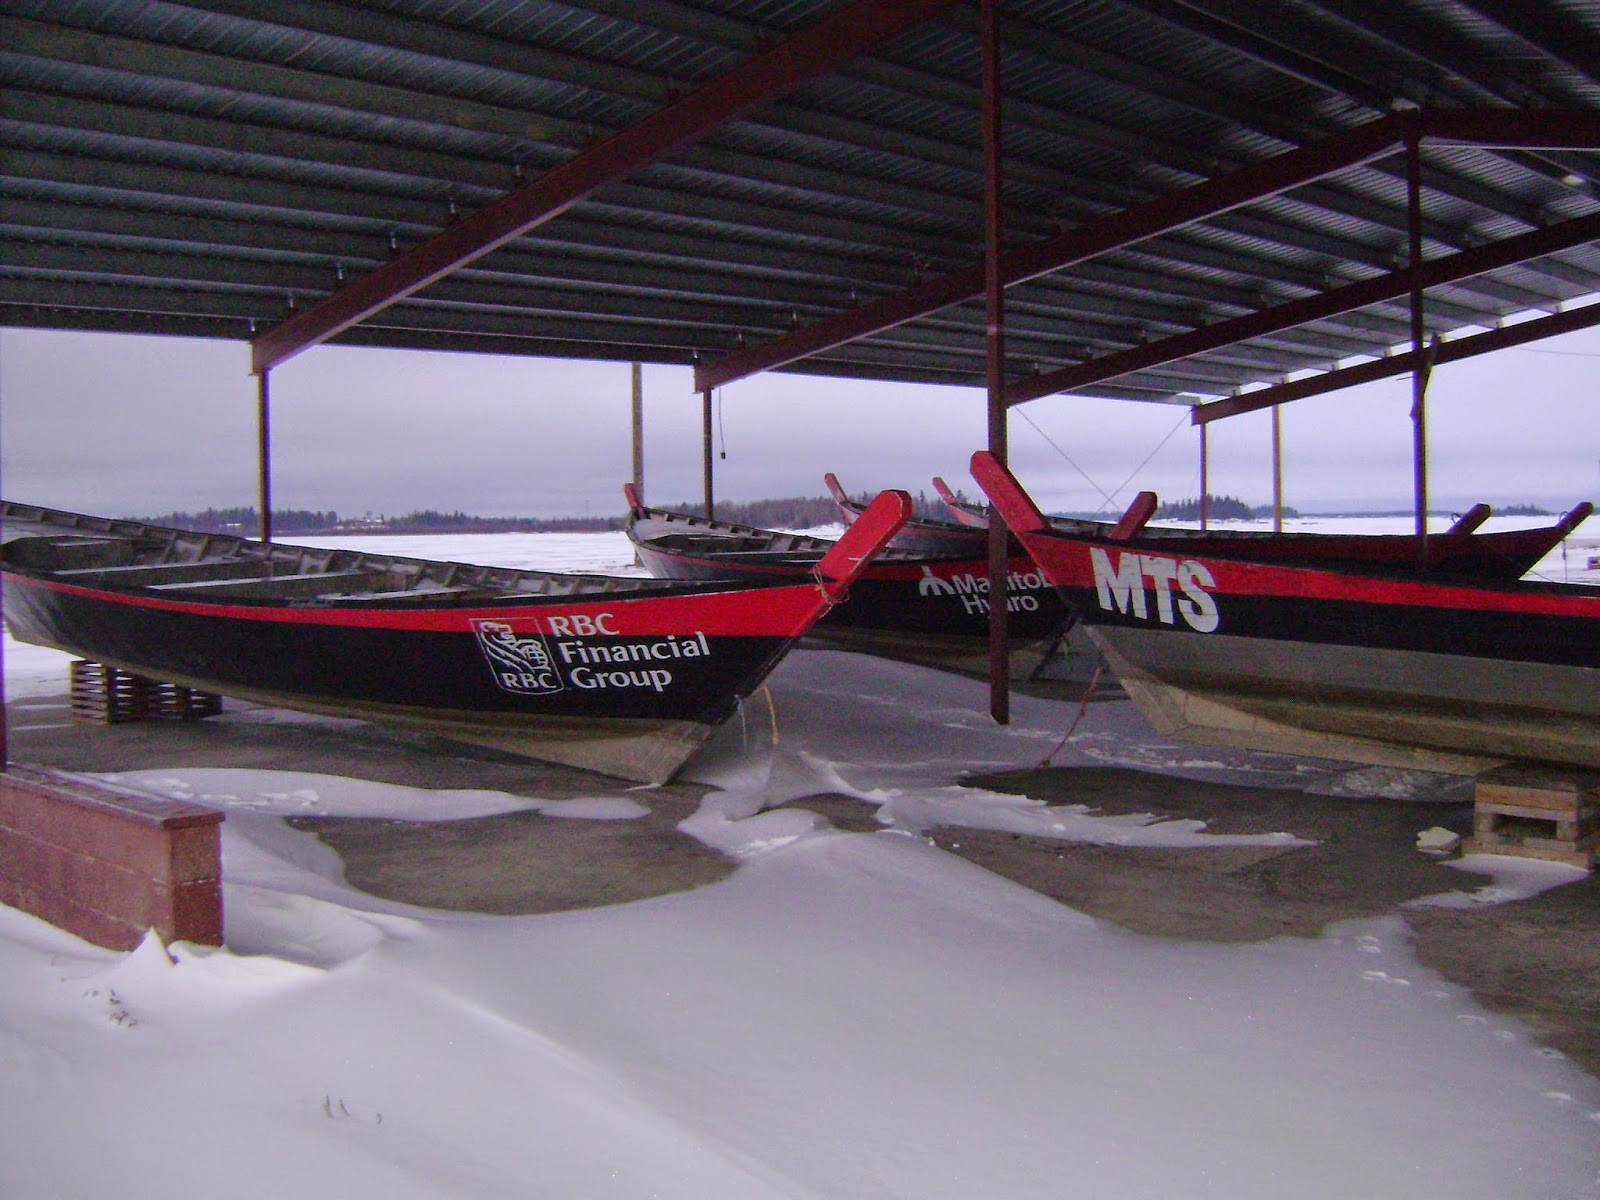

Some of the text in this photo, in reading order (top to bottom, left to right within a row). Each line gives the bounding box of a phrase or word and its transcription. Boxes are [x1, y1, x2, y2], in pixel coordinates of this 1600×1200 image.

[1090, 547, 1218, 633] MTS
[546, 613, 620, 638] RBC
[558, 631, 710, 664] Financial
[501, 672, 557, 689] RBC
[570, 667, 673, 692] Group
